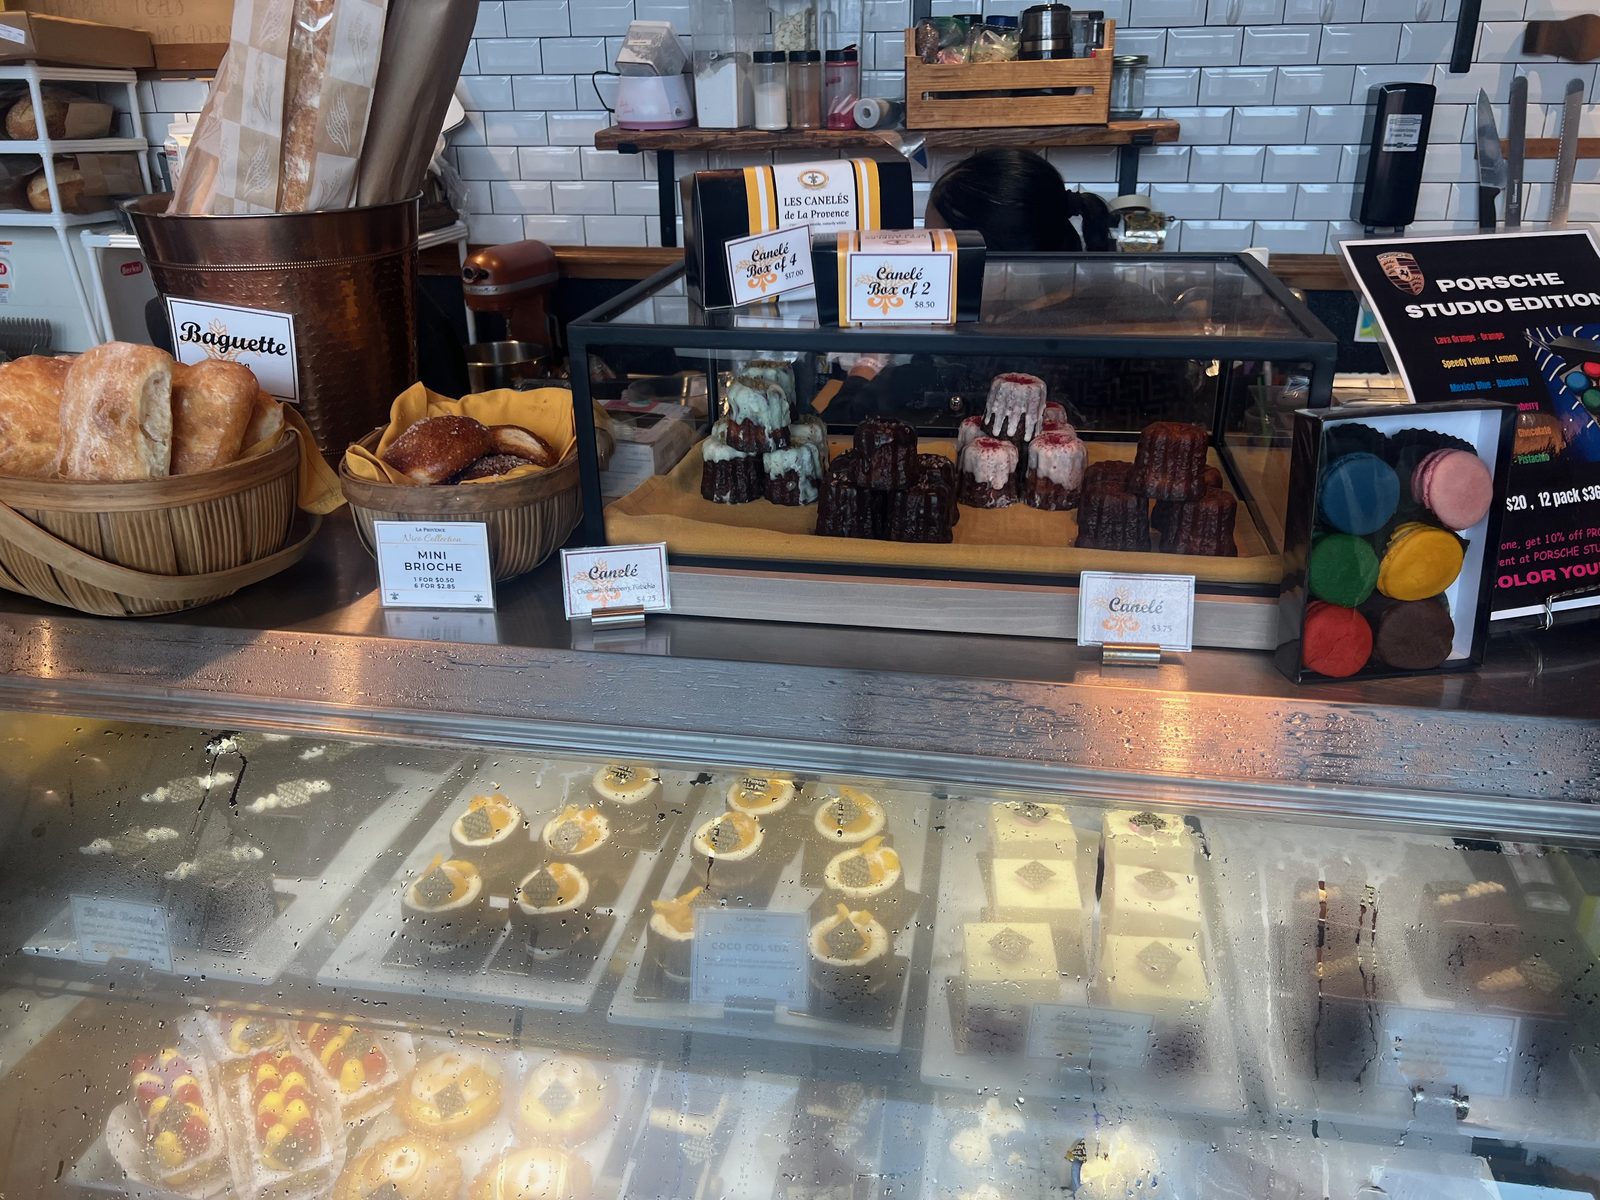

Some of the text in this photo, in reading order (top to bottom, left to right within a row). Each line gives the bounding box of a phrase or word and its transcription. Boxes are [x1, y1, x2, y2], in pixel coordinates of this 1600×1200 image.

[784, 192, 849, 206] LES CANELÉS
[784, 209, 850, 220] de La Provence
[751, 242, 789, 262] Canelé
[746, 252, 797, 278] Box of 4
[784, 269, 804, 280] $17.00
[876, 266, 923, 281] Canelé
[867, 281, 931, 299] Box of 2
[1436, 272, 1565, 293] PORSCHE
[914, 301, 935, 309] $8.50
[1405, 292, 1600, 319] STUDIO EDITION
[180, 321, 287, 356] Baguette
[1434, 336, 1452, 345] Lava
[1441, 358, 1467, 369] Speedy
[1467, 355, 1490, 366] Yellow
[1495, 354, 1519, 363] Lemon
[1449, 382, 1476, 393] Mexico
[1518, 426, 1552, 437] Chocolate
[1518, 453, 1550, 464] Pistachio
[1506, 495, 1527, 512] $20
[1538, 491, 1552, 507] 12
[1552, 488, 1581, 507] pack
[1501, 541, 1521, 550] one,
[1525, 537, 1541, 550] get
[1545, 532, 1565, 544] 10%
[1568, 530, 1583, 541] off
[418, 551, 447, 560] MINI
[1519, 555, 1530, 564] at
[1533, 546, 1580, 562] PORSCHE
[404, 562, 463, 572] BRIOCHE
[589, 563, 639, 580] Canelé
[1494, 562, 1600, 589] OLOR YOU
[1109, 597, 1164, 614] Canelé
[1152, 625, 1173, 633] $3.75
